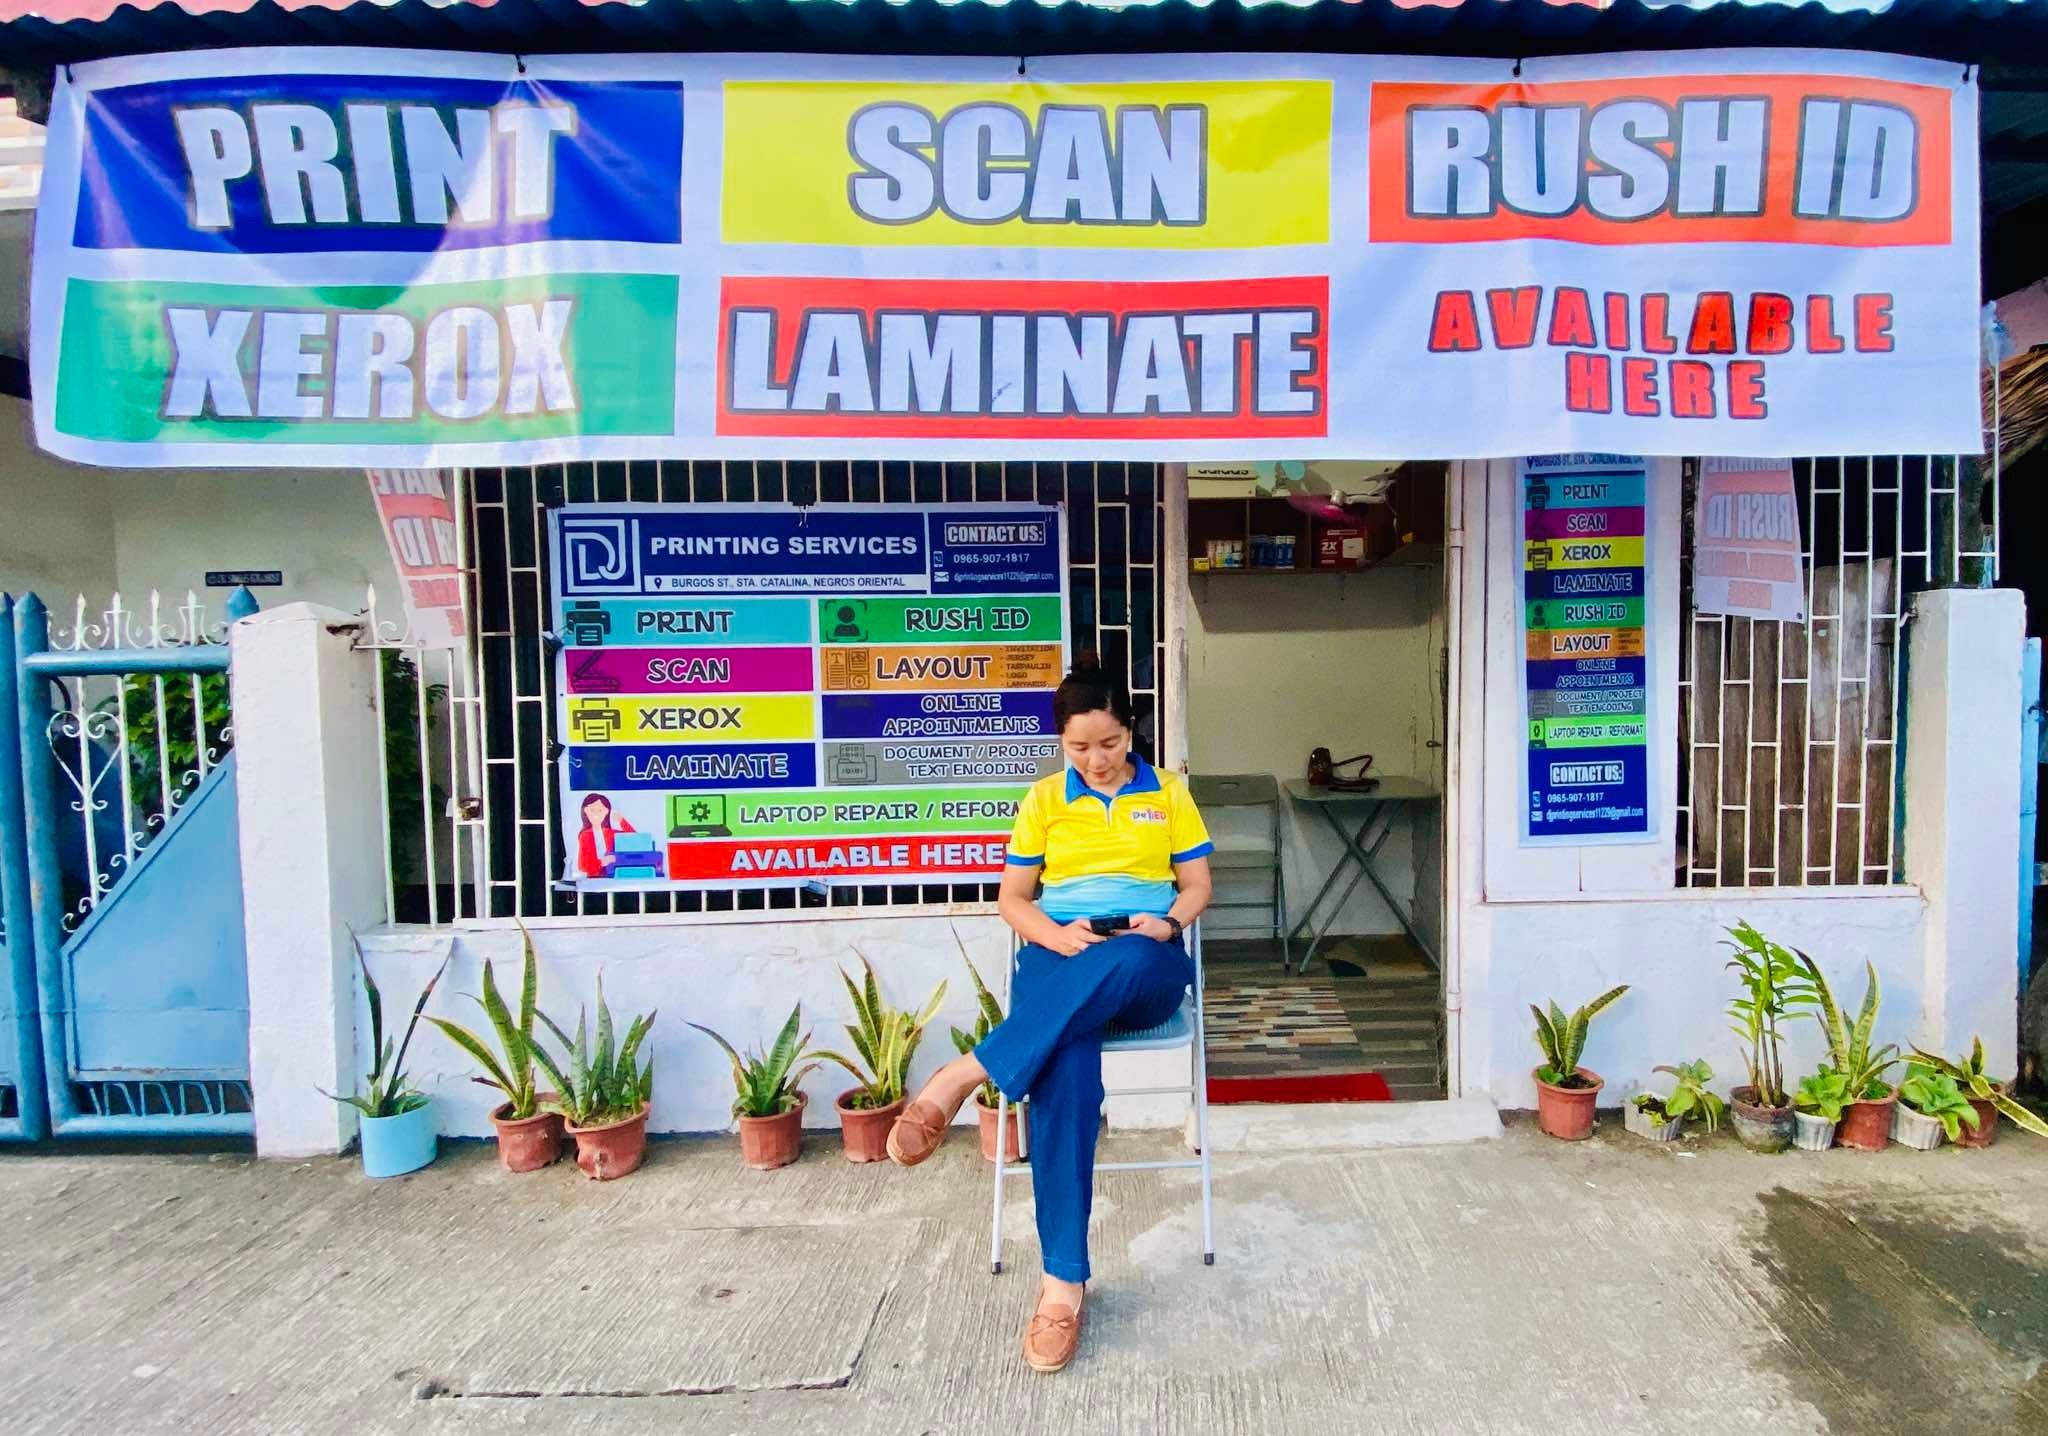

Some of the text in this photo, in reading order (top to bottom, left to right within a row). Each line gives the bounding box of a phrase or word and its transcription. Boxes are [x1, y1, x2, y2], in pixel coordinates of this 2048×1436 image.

[173, 102, 577, 230] PRINT
[848, 101, 1208, 225] SCAN
[1407, 95, 1919, 222] RUSH ID
[1428, 285, 1895, 354] AVAILABLE
[163, 298, 579, 421] XEROX
[726, 307, 1320, 418] LAMINATE
[1565, 351, 1768, 419] HERE
[1562, 483, 1609, 500] PRINT
[1567, 513, 1608, 531] SCAN
[948, 525, 1043, 542] CONTACT US:
[651, 536, 917, 555] PRINTING SERVICES
[1561, 544, 1612, 561] XEROX
[953, 553, 1030, 563] 0965-907-1817
[671, 578, 715, 588] BURGOS
[814, 577, 855, 587] NEGROS
[858, 576, 906, 587] ORIENTAL
[1553, 573, 1633, 593] LAMINATE
[905, 607, 1031, 632] RUSH ID
[1565, 603, 1626, 622] RUSH ID
[636, 610, 734, 635] PRINT
[1552, 634, 1612, 653] LAYOUT
[646, 658, 730, 684] SCAN
[876, 656, 993, 681] LAYOUT
[1576, 658, 1617, 671] ONLINE
[1556, 672, 1635, 688] APPOINTMENTS
[921, 694, 1001, 713] ONLINE
[1556, 690, 1601, 702] DOCUMENT
[1607, 688, 1644, 700] PROJECT
[1567, 701, 1634, 715] TEXT ENCODING
[638, 707, 742, 731] XEROX
[882, 716, 1040, 737] APPOINTMENTS
[1548, 726, 1576, 739] LAPTOP
[1577, 725, 1603, 738] REPAIR
[1608, 723, 1644, 737] REFORMAT
[884, 743, 1059, 761] DOCUMENT / PROJECT
[626, 752, 790, 781] LAMINATE
[907, 762, 1037, 777] TEXT ENCODING
[1553, 765, 1622, 783] CONTACT US:
[1547, 792, 1605, 803] 0965-907-1817
[739, 805, 828, 824] LAPTOP
[834, 802, 919, 822] REPAIR
[925, 802, 934, 820] /
[731, 845, 910, 871] AVAILABLE
